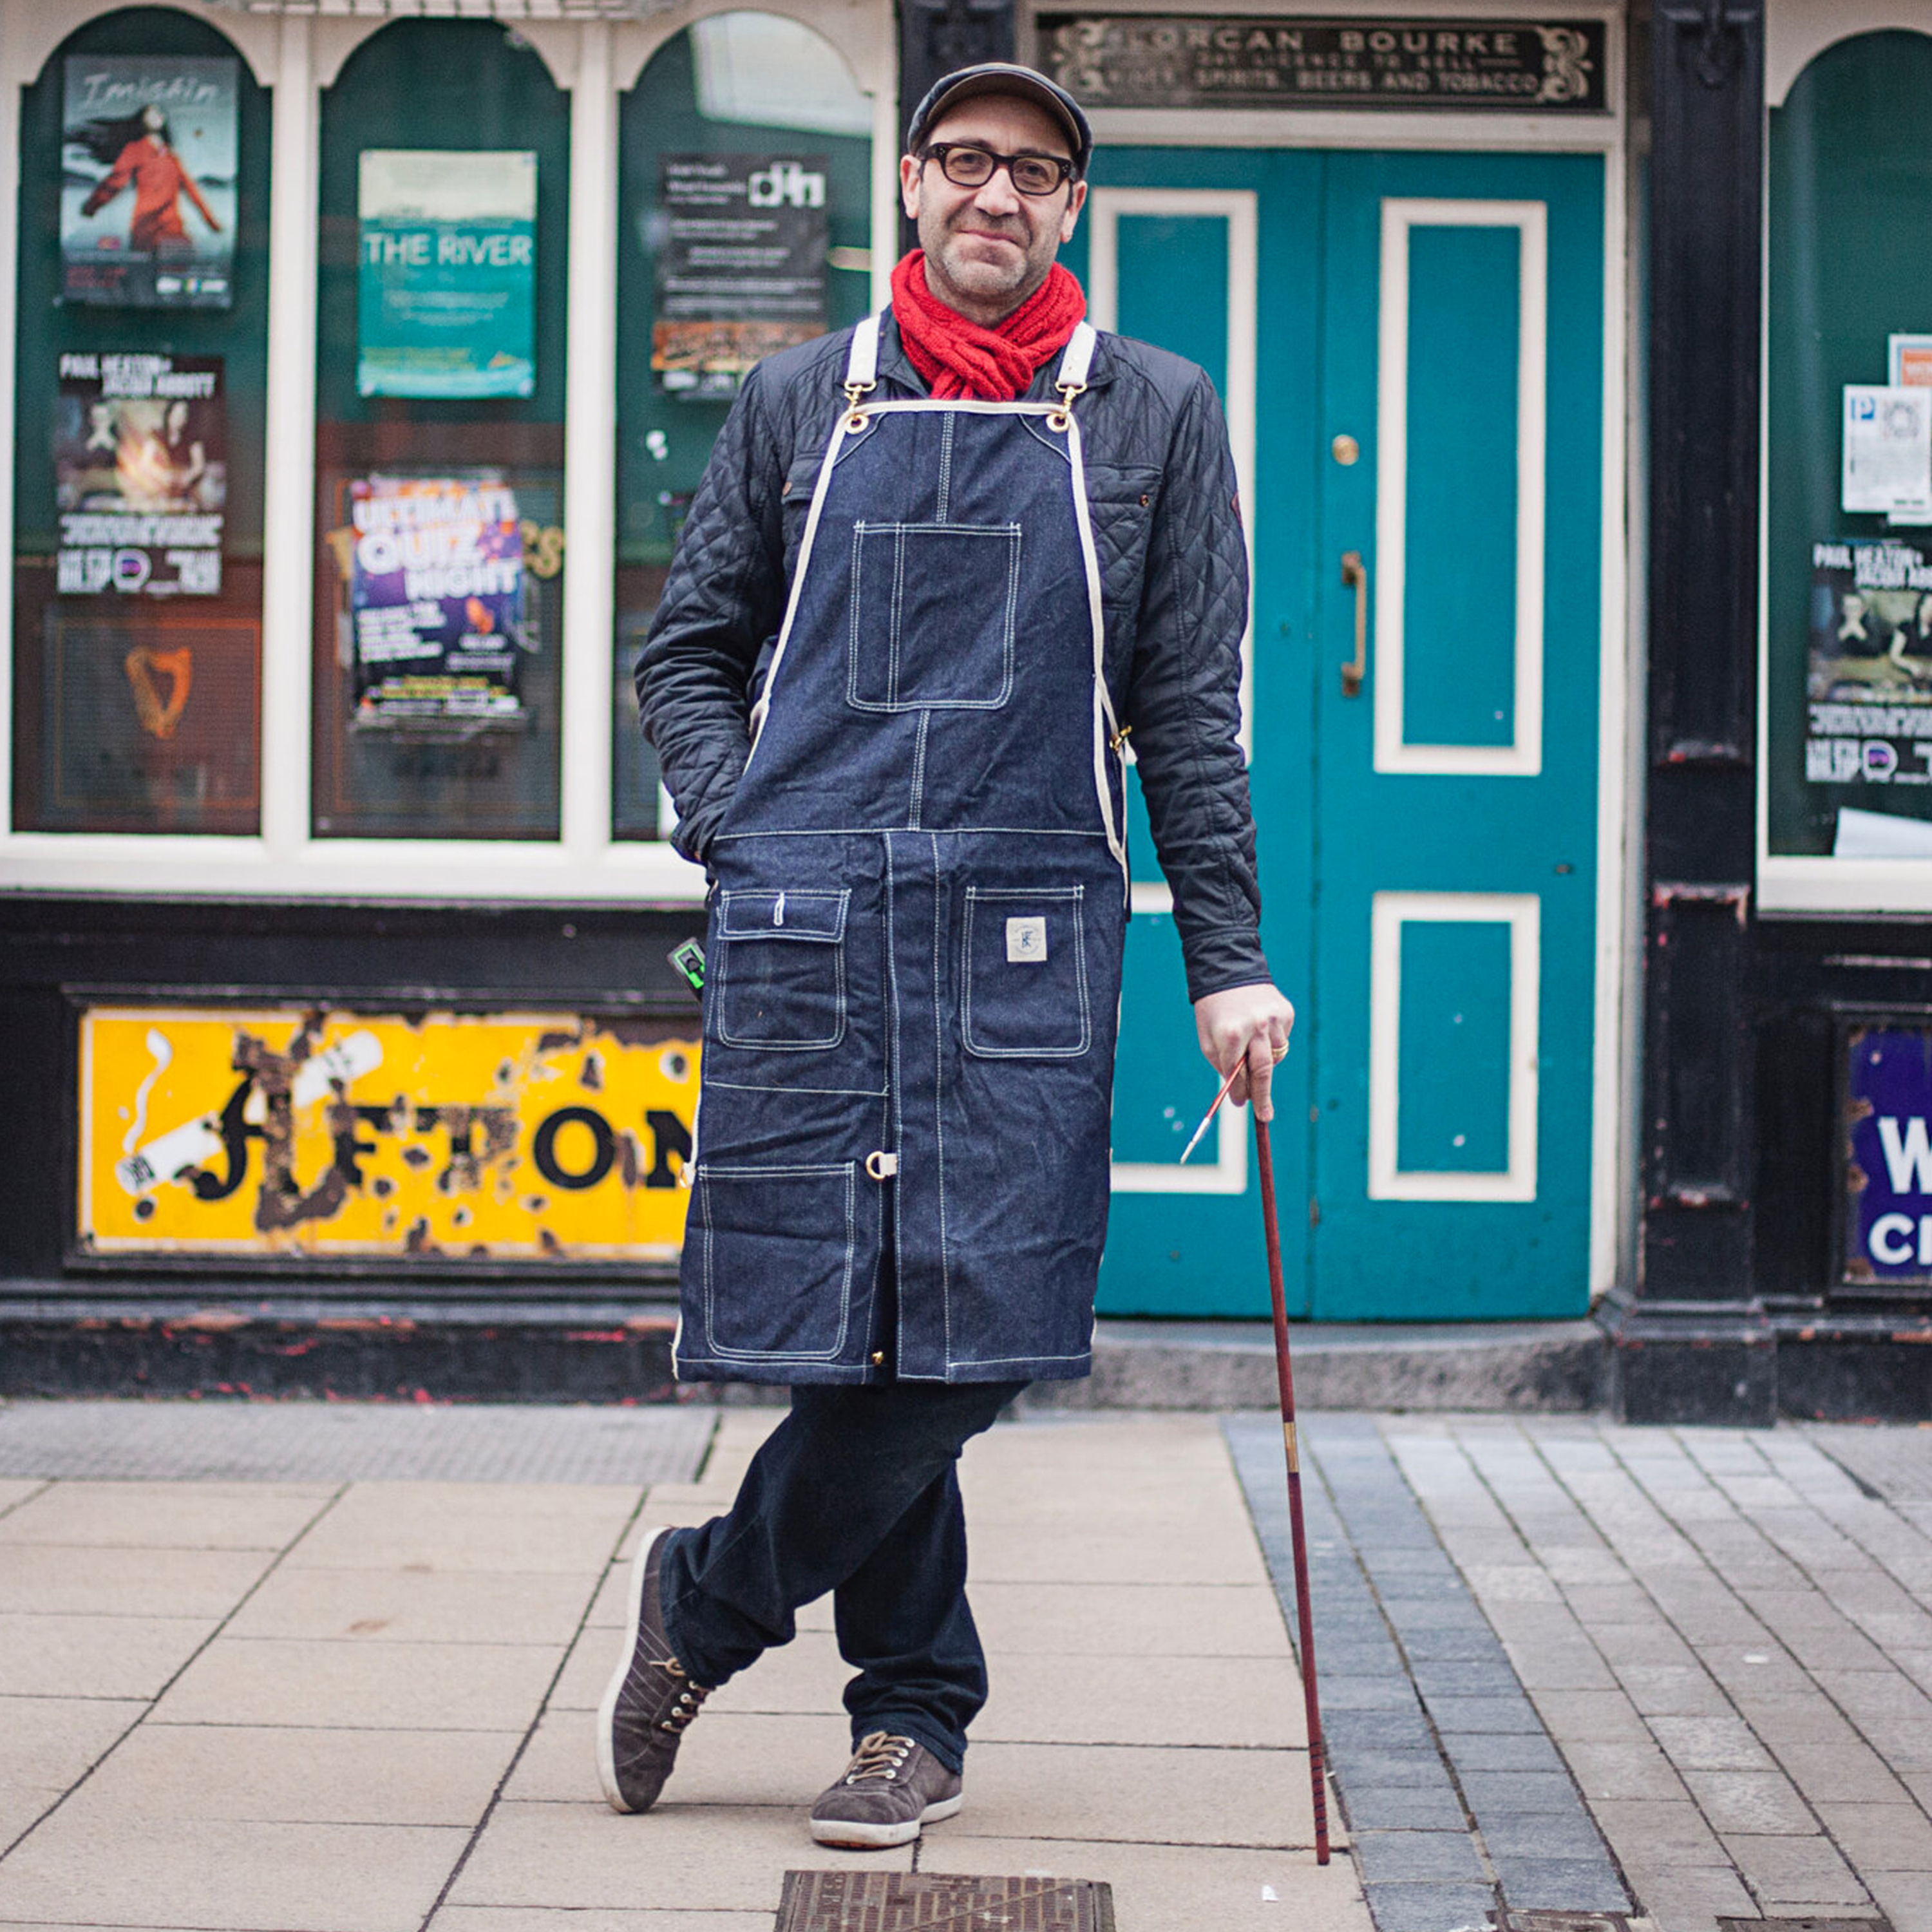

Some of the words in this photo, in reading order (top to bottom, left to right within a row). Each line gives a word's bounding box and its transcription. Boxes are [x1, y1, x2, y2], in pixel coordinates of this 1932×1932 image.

[1339, 31, 1519, 55] BOURKE
[1383, 71, 1431, 91] AND
[1435, 71, 1539, 92] TOBACCO
[364, 232, 430, 266] THE
[438, 234, 534, 267] RIVER
[357, 522, 484, 575] QUIZ
[405, 557, 523, 601] NIGHT
